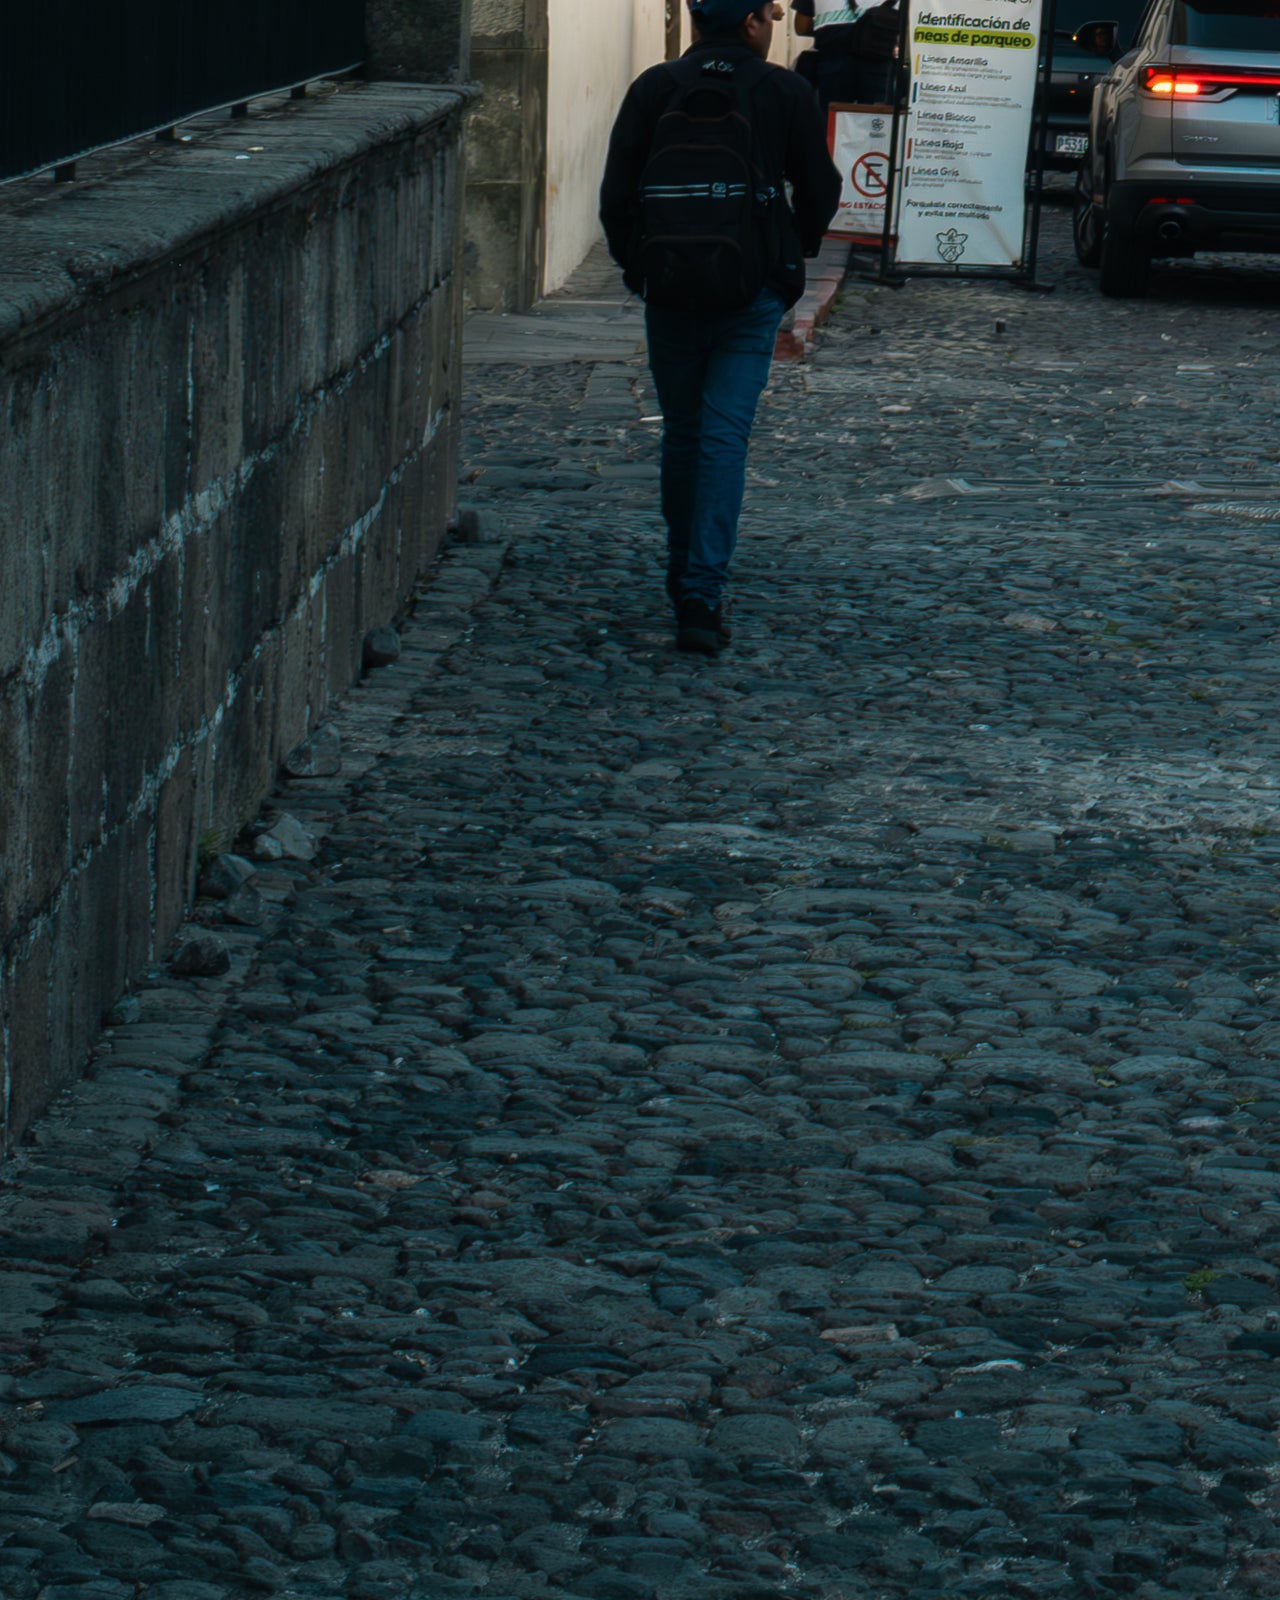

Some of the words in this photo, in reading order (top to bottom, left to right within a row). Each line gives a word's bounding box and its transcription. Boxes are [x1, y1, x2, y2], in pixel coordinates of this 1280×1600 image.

[918, 11, 1010, 30] Identificación
[1013, 18, 1031, 31] de
[951, 30, 969, 43] de
[971, 35, 1031, 48] parqueo
